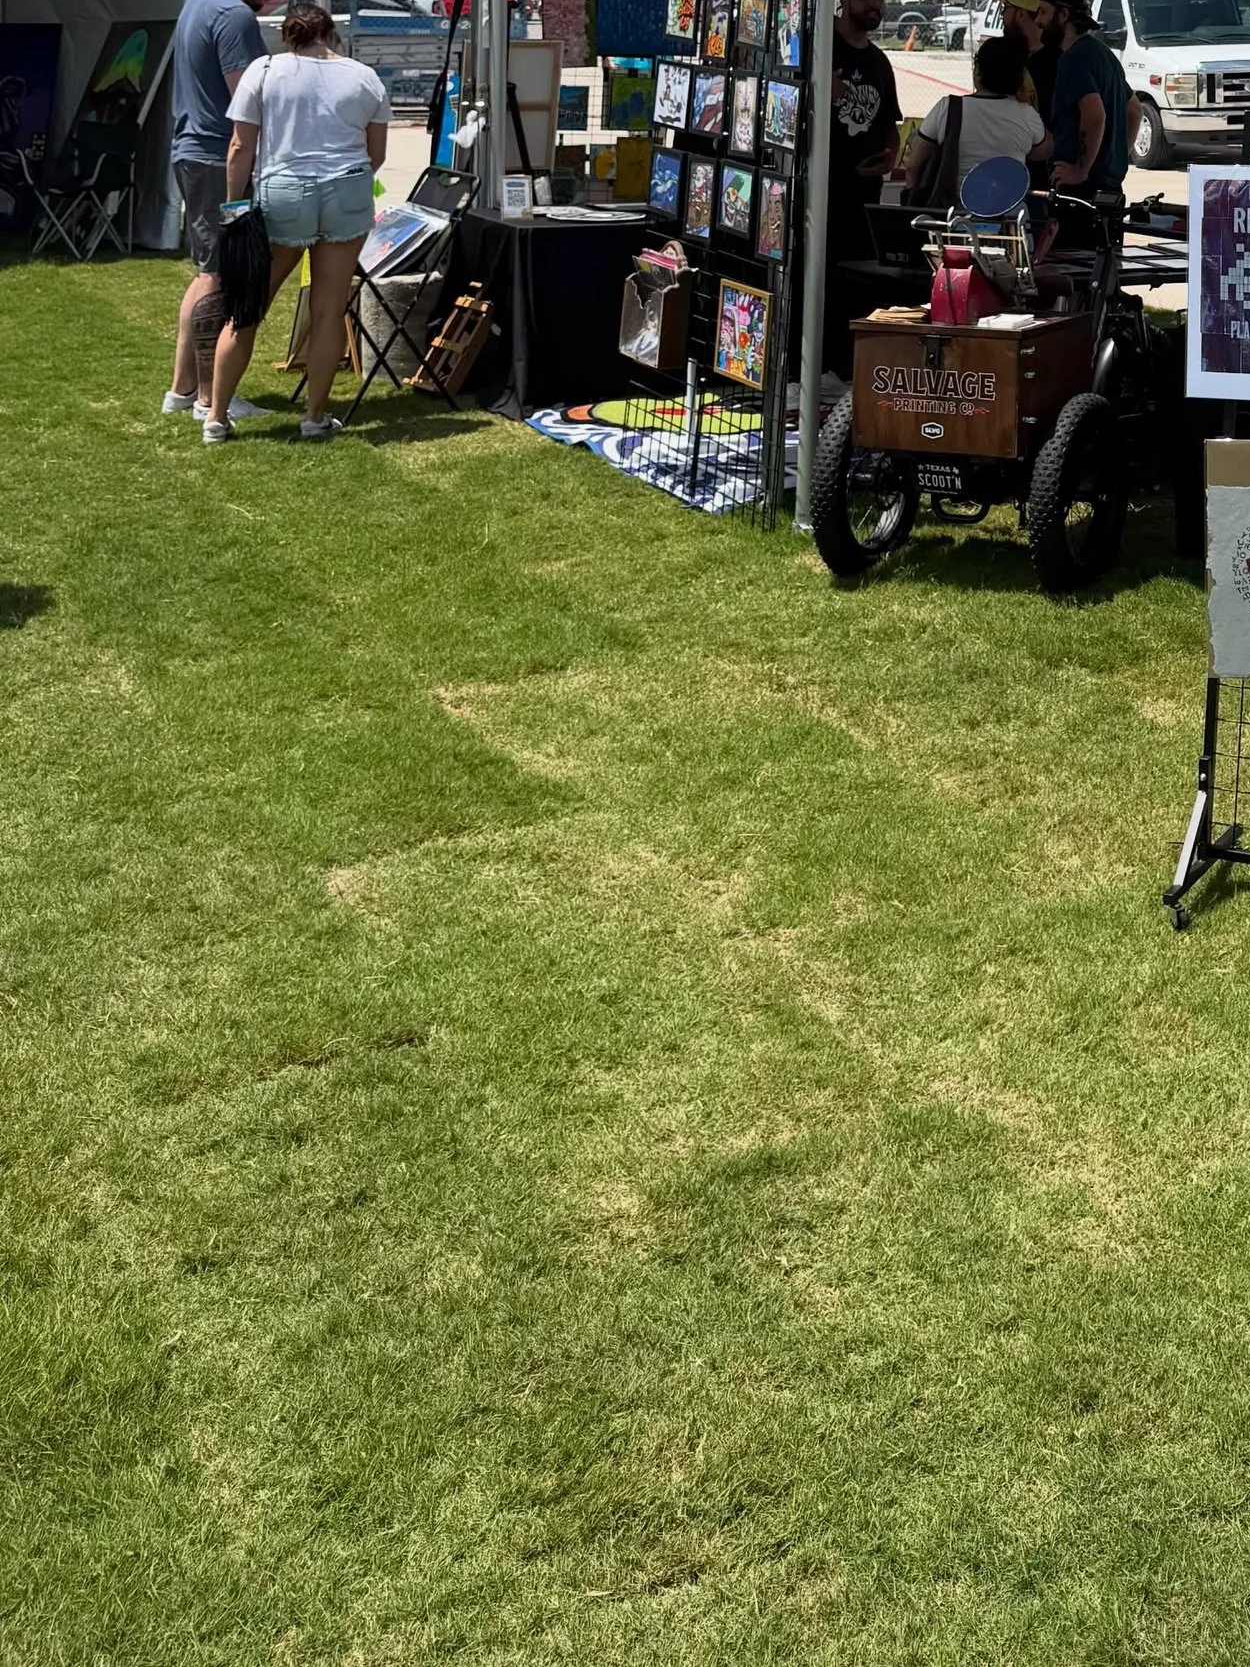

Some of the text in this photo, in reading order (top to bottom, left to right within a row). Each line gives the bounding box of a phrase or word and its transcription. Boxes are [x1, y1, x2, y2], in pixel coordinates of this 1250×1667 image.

[872, 366, 996, 401] SALVAGE
[893, 398, 956, 415] PRINTING
[925, 464, 950, 473] TEXAS
